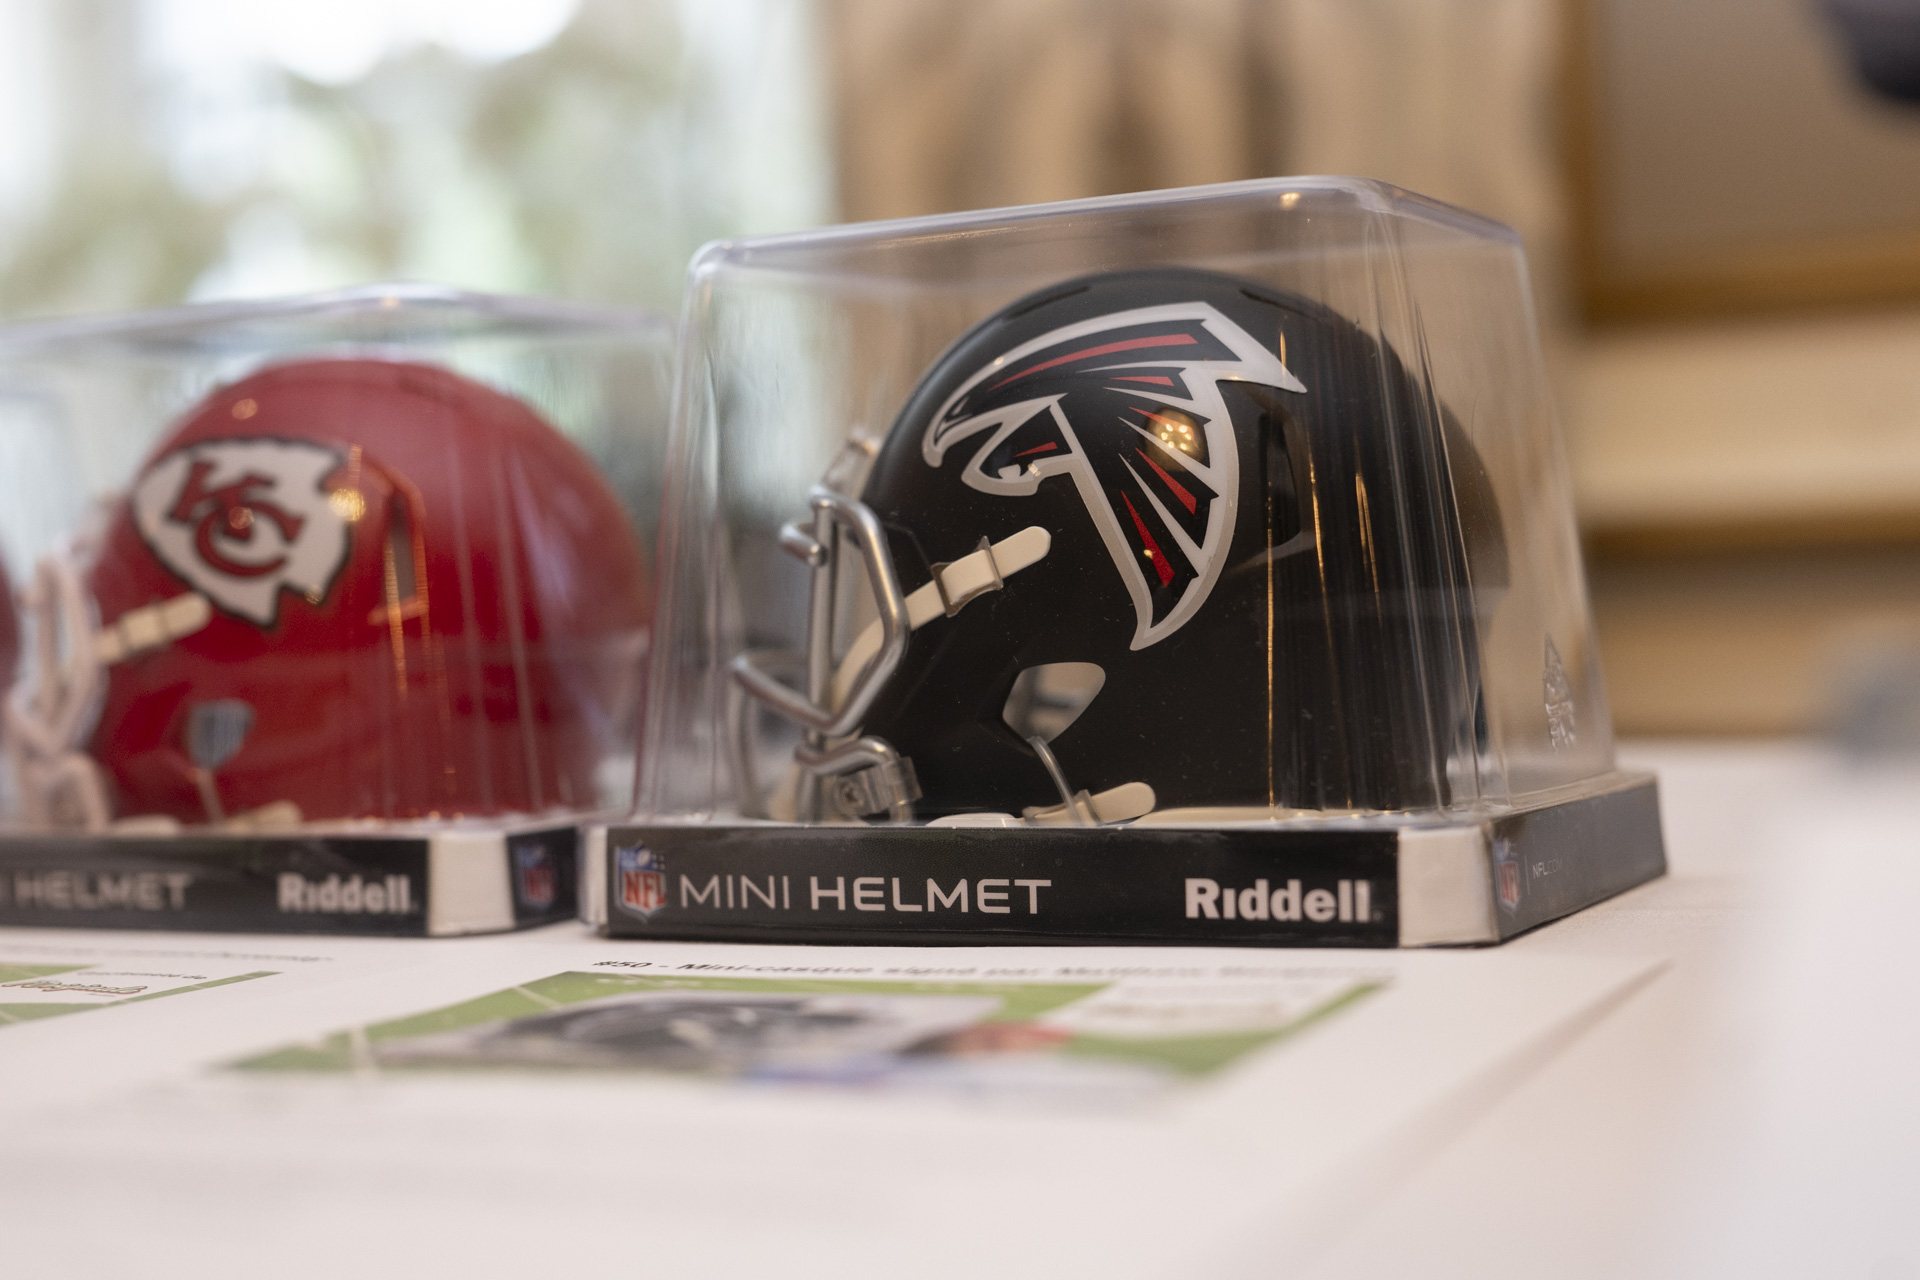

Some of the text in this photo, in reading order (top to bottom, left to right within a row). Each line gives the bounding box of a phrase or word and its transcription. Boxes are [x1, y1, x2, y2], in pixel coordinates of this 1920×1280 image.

[165, 461, 306, 577] KC
[14, 872, 191, 910] HELMET
[277, 873, 410, 914] Riddell
[624, 872, 666, 910] NFL
[680, 874, 1052, 915] MINI HELMET
[1185, 878, 1370, 922] Riddell
